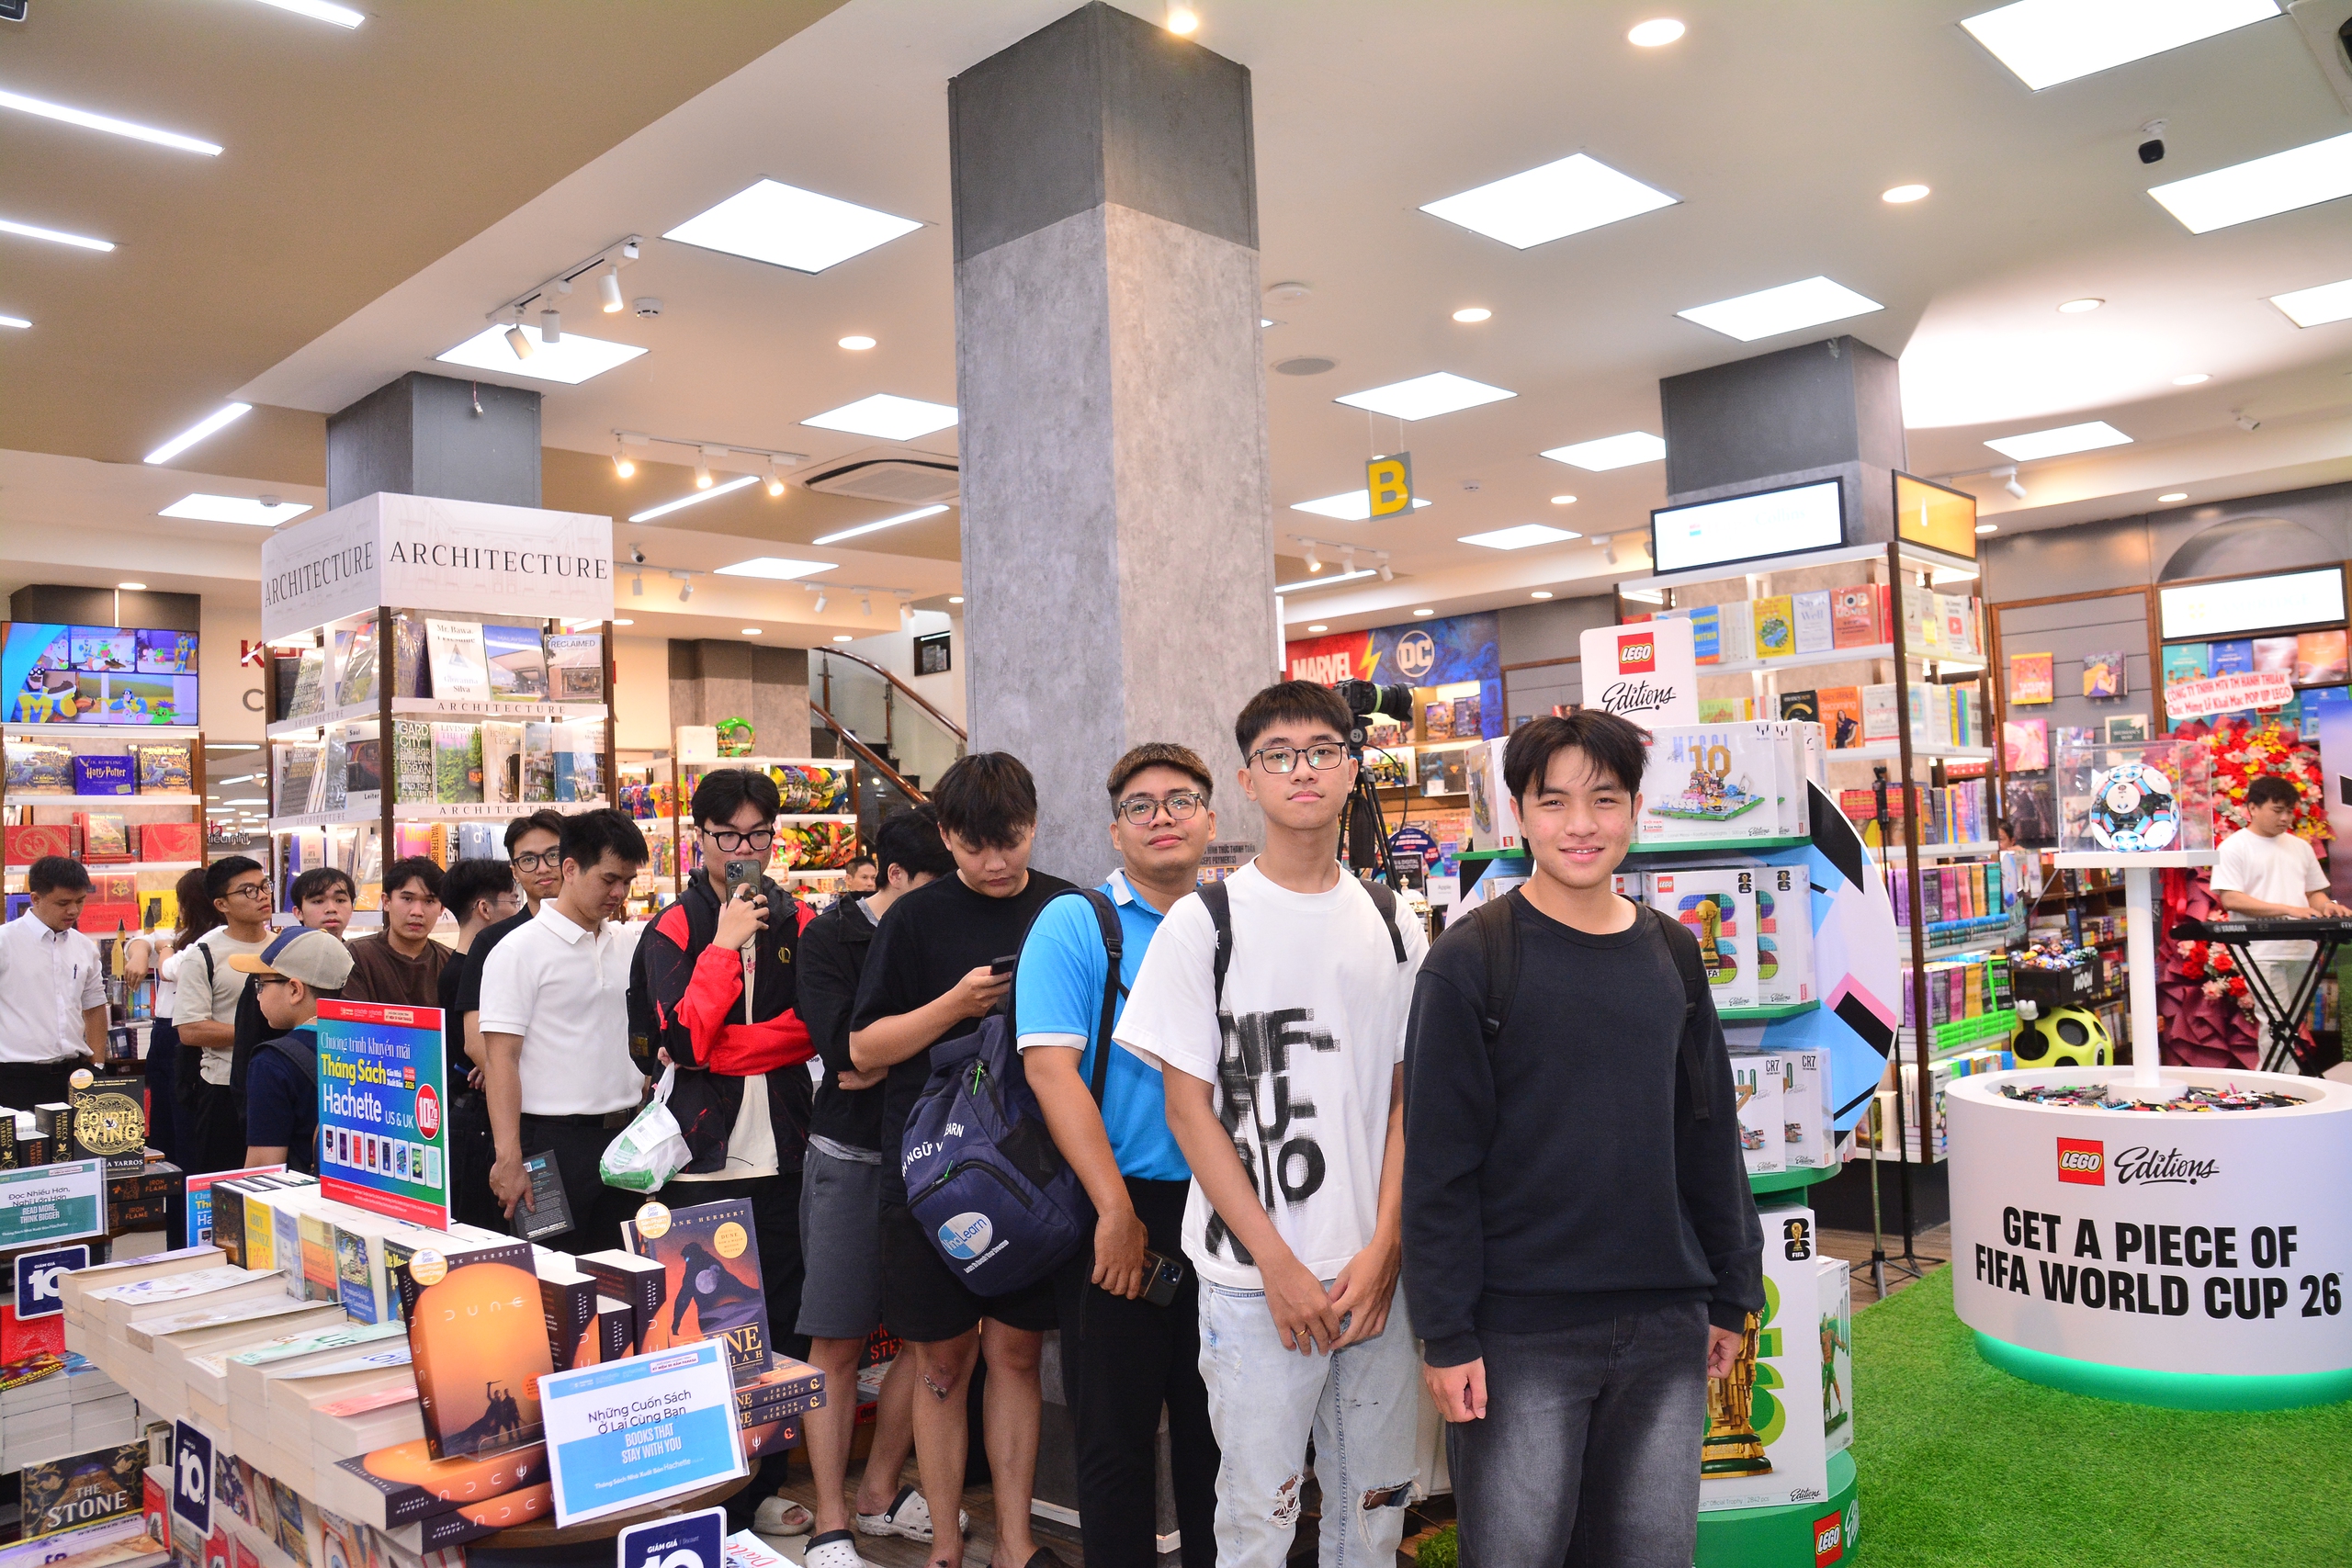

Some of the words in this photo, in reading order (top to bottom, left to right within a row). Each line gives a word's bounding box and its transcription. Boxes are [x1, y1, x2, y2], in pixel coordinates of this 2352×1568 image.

[1374, 459, 1408, 517] B
[389, 541, 608, 580] ARCHITECTURE
[264, 541, 374, 608] ARCHITECTURE
[1836, 592, 1868, 608] JOB
[1802, 609, 1824, 620] Well
[1836, 608, 1869, 618] MOVES
[550, 639, 595, 648] RECLAIMED
[1398, 640, 1432, 670] DC
[1620, 643, 1653, 665] LEGO
[1292, 651, 1353, 684] MARVEL
[1601, 680, 1675, 715] Editions
[2245, 691, 2259, 705] POP
[2260, 689, 2270, 702] UP
[2272, 686, 2290, 700] LEGO
[437, 702, 566, 715] ARCHITECTURE
[1820, 701, 1857, 712] Becoming
[295, 709, 345, 728] ARCHITECTURE
[1821, 712, 1835, 721] You
[399, 736, 422, 748] CITY
[85, 767, 105, 779] Harry
[106, 766, 127, 779] Potter
[401, 764, 432, 774] URBAN
[296, 812, 345, 825] ARCHITECTURE
[431, 825, 439, 851] WALTER
[1766, 1060, 1781, 1072] CR7
[1802, 1055, 1816, 1067] CR7
[321, 1054, 356, 1086] Tháng
[357, 1058, 387, 1085] Sách
[323, 1083, 382, 1122] Hachette
[386, 1110, 395, 1125] US
[397, 1112, 402, 1126] &
[402, 1114, 414, 1130] UK
[419, 1097, 438, 1128] 10%
[80, 1111, 139, 1126] FOURTH
[80, 1124, 140, 1144] WING
[906, 1141, 933, 1165] NGỮ
[2060, 1150, 2101, 1174] LEGO
[2113, 1146, 2220, 1185] Editions
[145, 1184, 168, 1192] FLAME
[22, 1207, 38, 1215] READ
[39, 1203, 58, 1213] MORE,
[125, 1212, 149, 1220] FLAME
[698, 1210, 745, 1223] HERBERT
[20, 1215, 38, 1224] THINK
[39, 1211, 61, 1222] BIGGER
[944, 1218, 988, 1252] VinaLearn
[2003, 1206, 2061, 1254] GET
[2074, 1218, 2102, 1260] A
[2116, 1222, 2236, 1269] PIECE
[2251, 1224, 2298, 1269] OF
[474, 1247, 526, 1262] HERBERT
[1975, 1243, 2030, 1297] FIFA
[2040, 1261, 2189, 1318] WORLD
[2204, 1276, 2289, 1320] CUP
[2300, 1274, 2342, 1318] 26
[763, 1388, 805, 1402] HERBERT
[770, 1383, 798, 1394] FRANK
[588, 1405, 629, 1423] Những
[631, 1396, 662, 1411] Cuốn
[664, 1390, 692, 1405] Sách
[763, 1405, 805, 1420] HERBERT
[770, 1402, 798, 1413] FRANK
[598, 1421, 608, 1435] Ở
[611, 1419, 628, 1433] Lại
[630, 1413, 662, 1429] Cùng
[664, 1406, 686, 1420] Bạn
[625, 1428, 654, 1448] BOOKS
[653, 1423, 674, 1440] THAT
[621, 1447, 641, 1464] STAY
[642, 1441, 665, 1459] WITH
[665, 1437, 683, 1453] YOU
[663, 1458, 692, 1472] Hachette
[179, 1448, 206, 1506] 10%
[75, 1483, 102, 1499] THE
[1790, 1487, 1821, 1502] Editions
[395, 1500, 430, 1515] HERBERT
[400, 1496, 425, 1507] FRANK
[1725, 1497, 1744, 1506] Trophy
[47, 1490, 130, 1529] STONE
[432, 1525, 465, 1539] HERBERT
[436, 1521, 460, 1532] FRANK
[647, 1542, 666, 1554] GIẢM
[666, 1539, 678, 1549] GIÁ
[1817, 1526, 1840, 1554] LEGO
